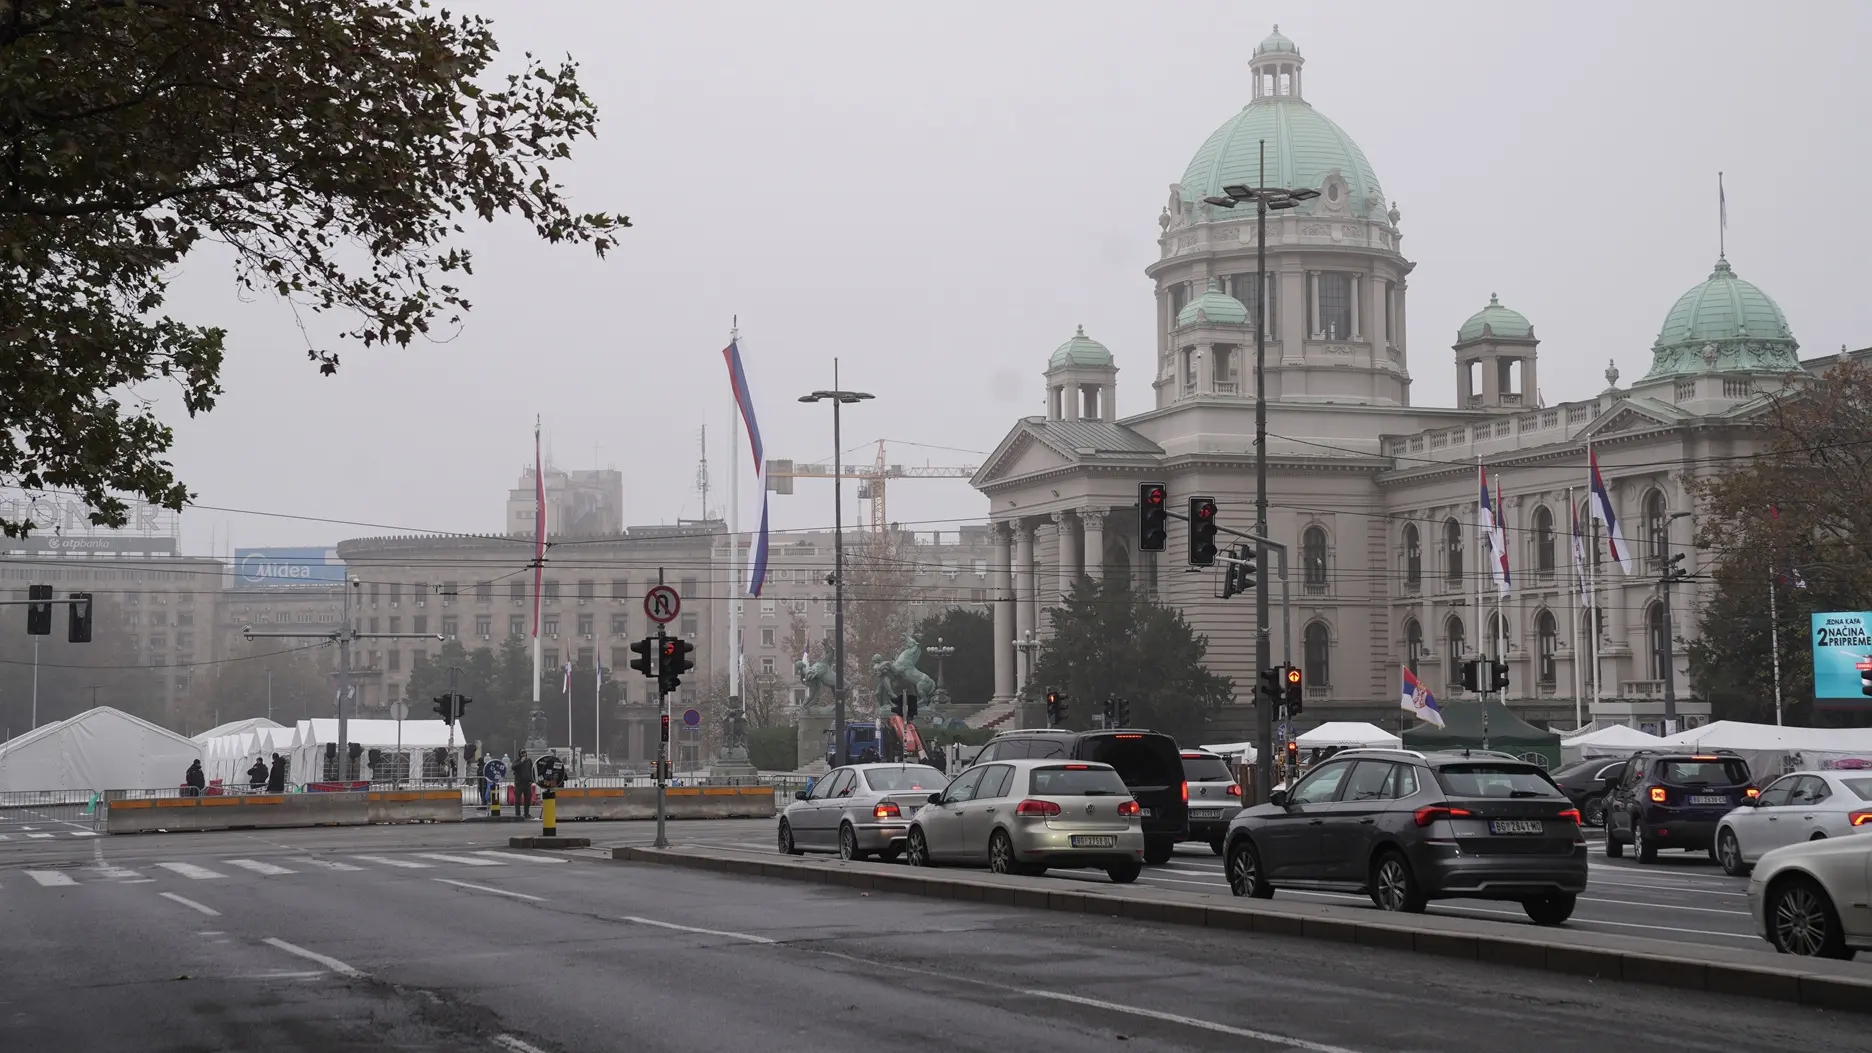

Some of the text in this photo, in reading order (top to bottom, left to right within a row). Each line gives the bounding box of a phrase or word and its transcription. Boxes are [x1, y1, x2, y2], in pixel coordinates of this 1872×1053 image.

[62, 540, 110, 550] otpbanka
[256, 562, 310, 577] Midea
[1825, 617, 1861, 626] JEDNA KAFA
[1817, 626, 1865, 647] 2 NAČINA
[1829, 637, 1872, 647] PRIPREME
[1495, 821, 1506, 831] BG
